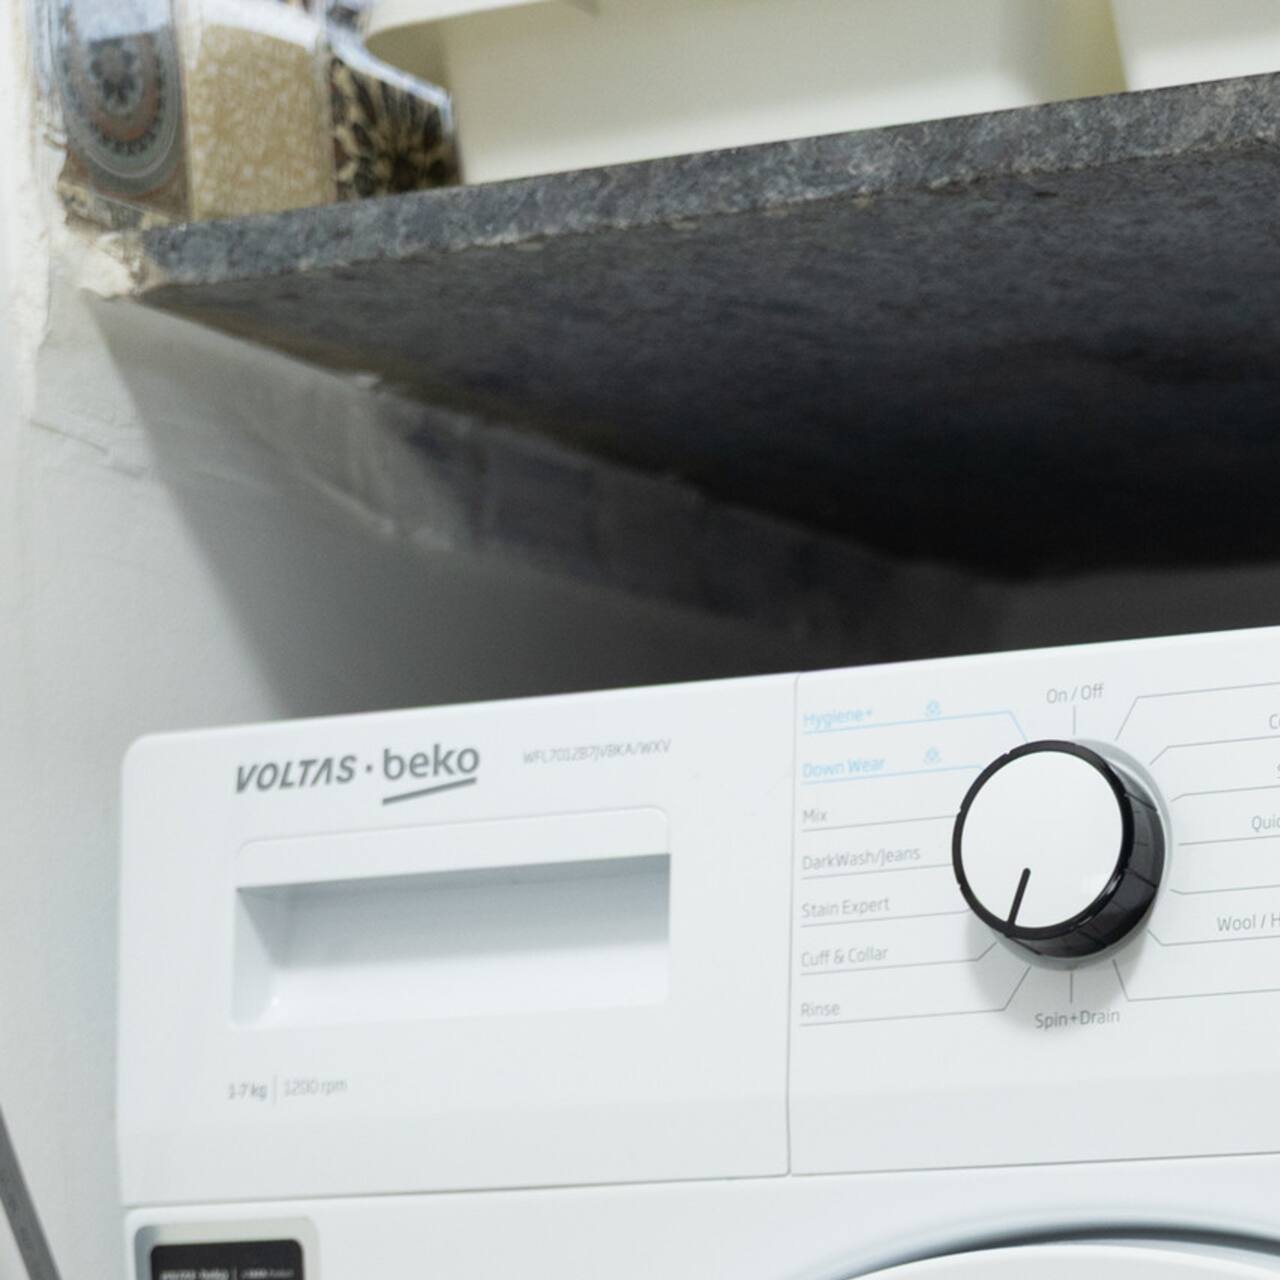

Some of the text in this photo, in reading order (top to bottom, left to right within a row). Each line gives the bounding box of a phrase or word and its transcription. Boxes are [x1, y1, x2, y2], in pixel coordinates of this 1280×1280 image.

[1046, 686, 1068, 703] On
[1081, 683, 1105, 700] Off
[235, 743, 480, 793] VOLTAS beko
[802, 757, 885, 778] Down Wear
[802, 808, 828, 823] Mix
[801, 898, 890, 919] Stain Expert
[1217, 914, 1256, 932] Wool
[801, 946, 888, 968] Cuff & Collar
[800, 1002, 841, 1017] Rinse
[1035, 1010, 1120, 1029] Spin+Drain
